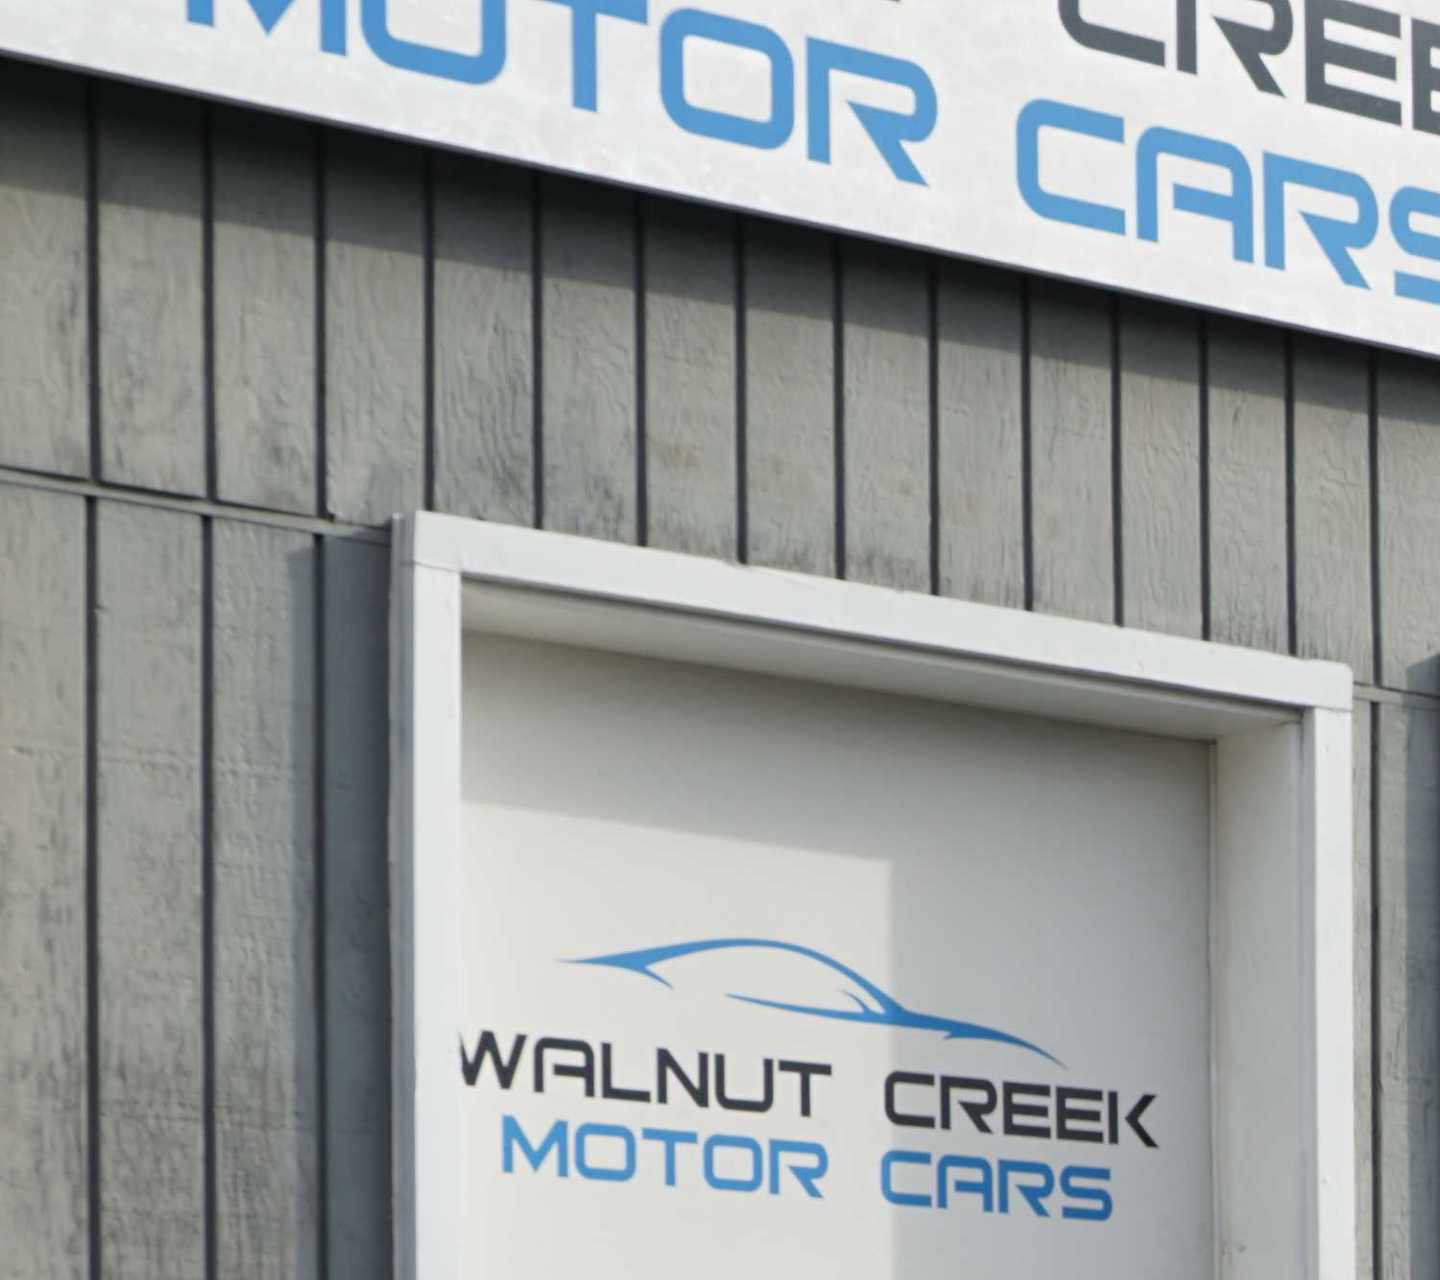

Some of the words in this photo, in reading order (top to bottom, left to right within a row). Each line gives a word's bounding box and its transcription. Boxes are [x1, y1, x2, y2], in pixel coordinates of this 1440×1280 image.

[458, 1029, 831, 1117] WALNUT
[884, 1071, 1159, 1149] CREEK
[502, 1115, 828, 1198] MOTOR
[880, 1150, 1114, 1221] CARS
